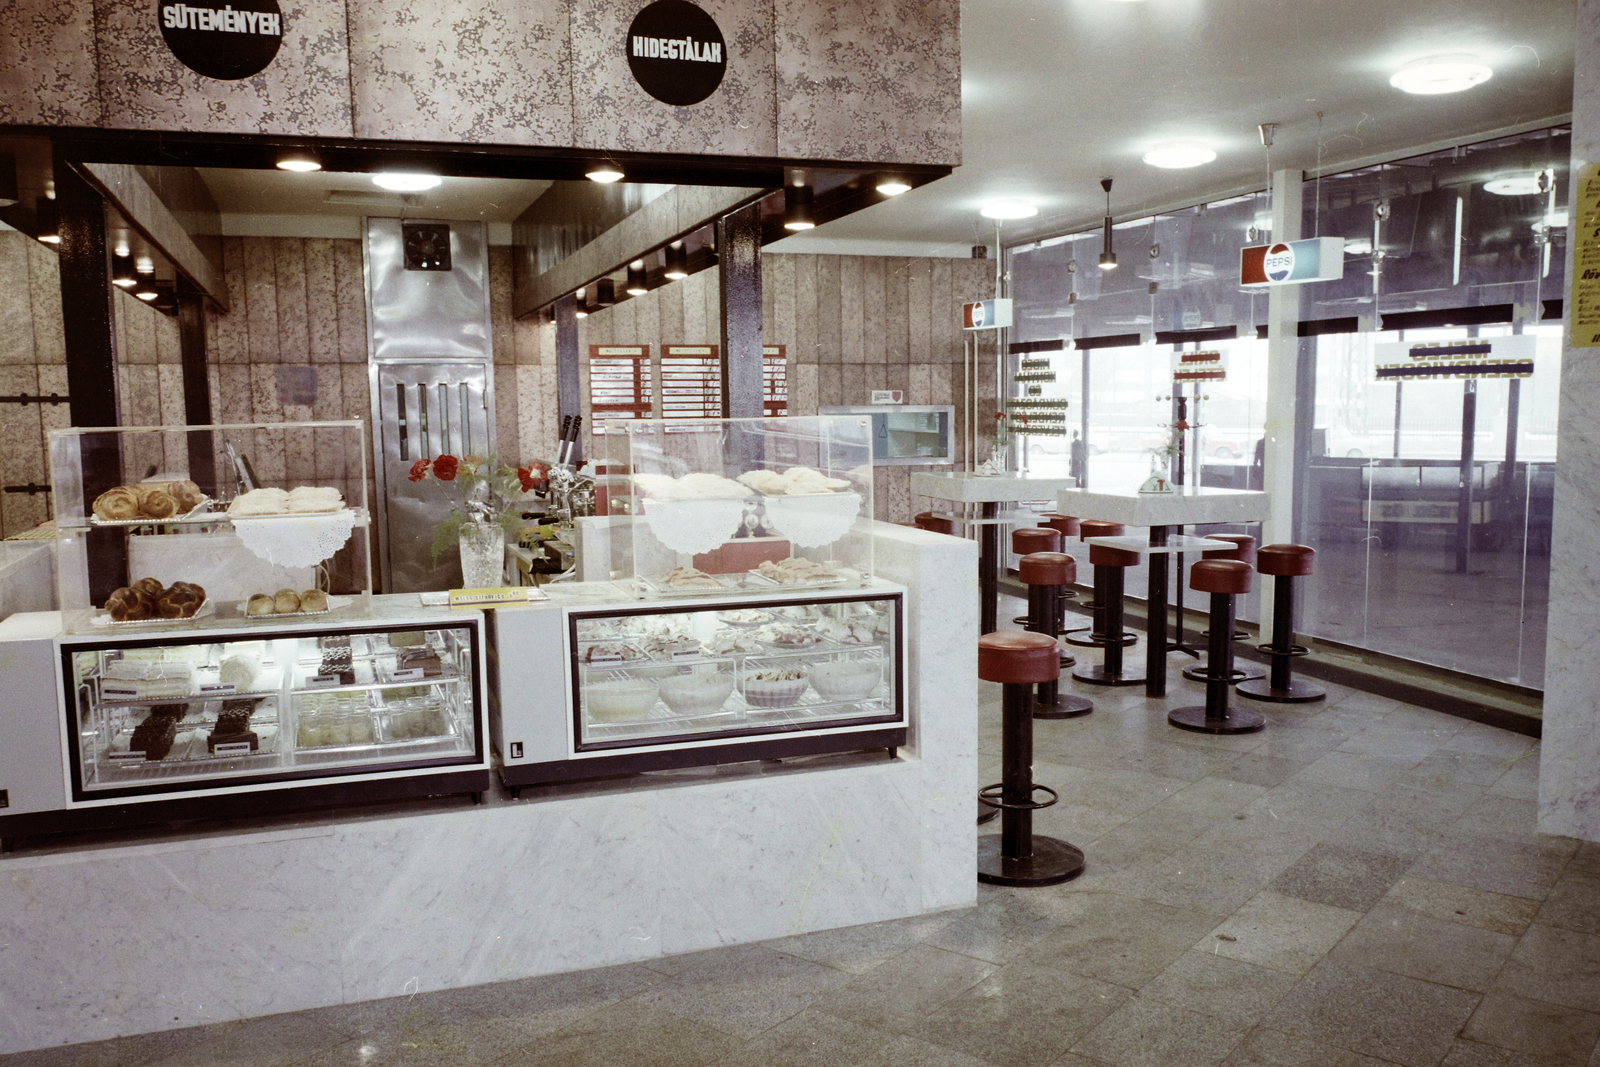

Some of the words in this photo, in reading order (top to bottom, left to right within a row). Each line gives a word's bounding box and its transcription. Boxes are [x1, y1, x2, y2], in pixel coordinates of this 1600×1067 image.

[163, 3, 280, 36] SÜTEMÉNYEK
[633, 36, 721, 63] HIDEGTÁLAK
[1266, 256, 1293, 267] PEPSI
